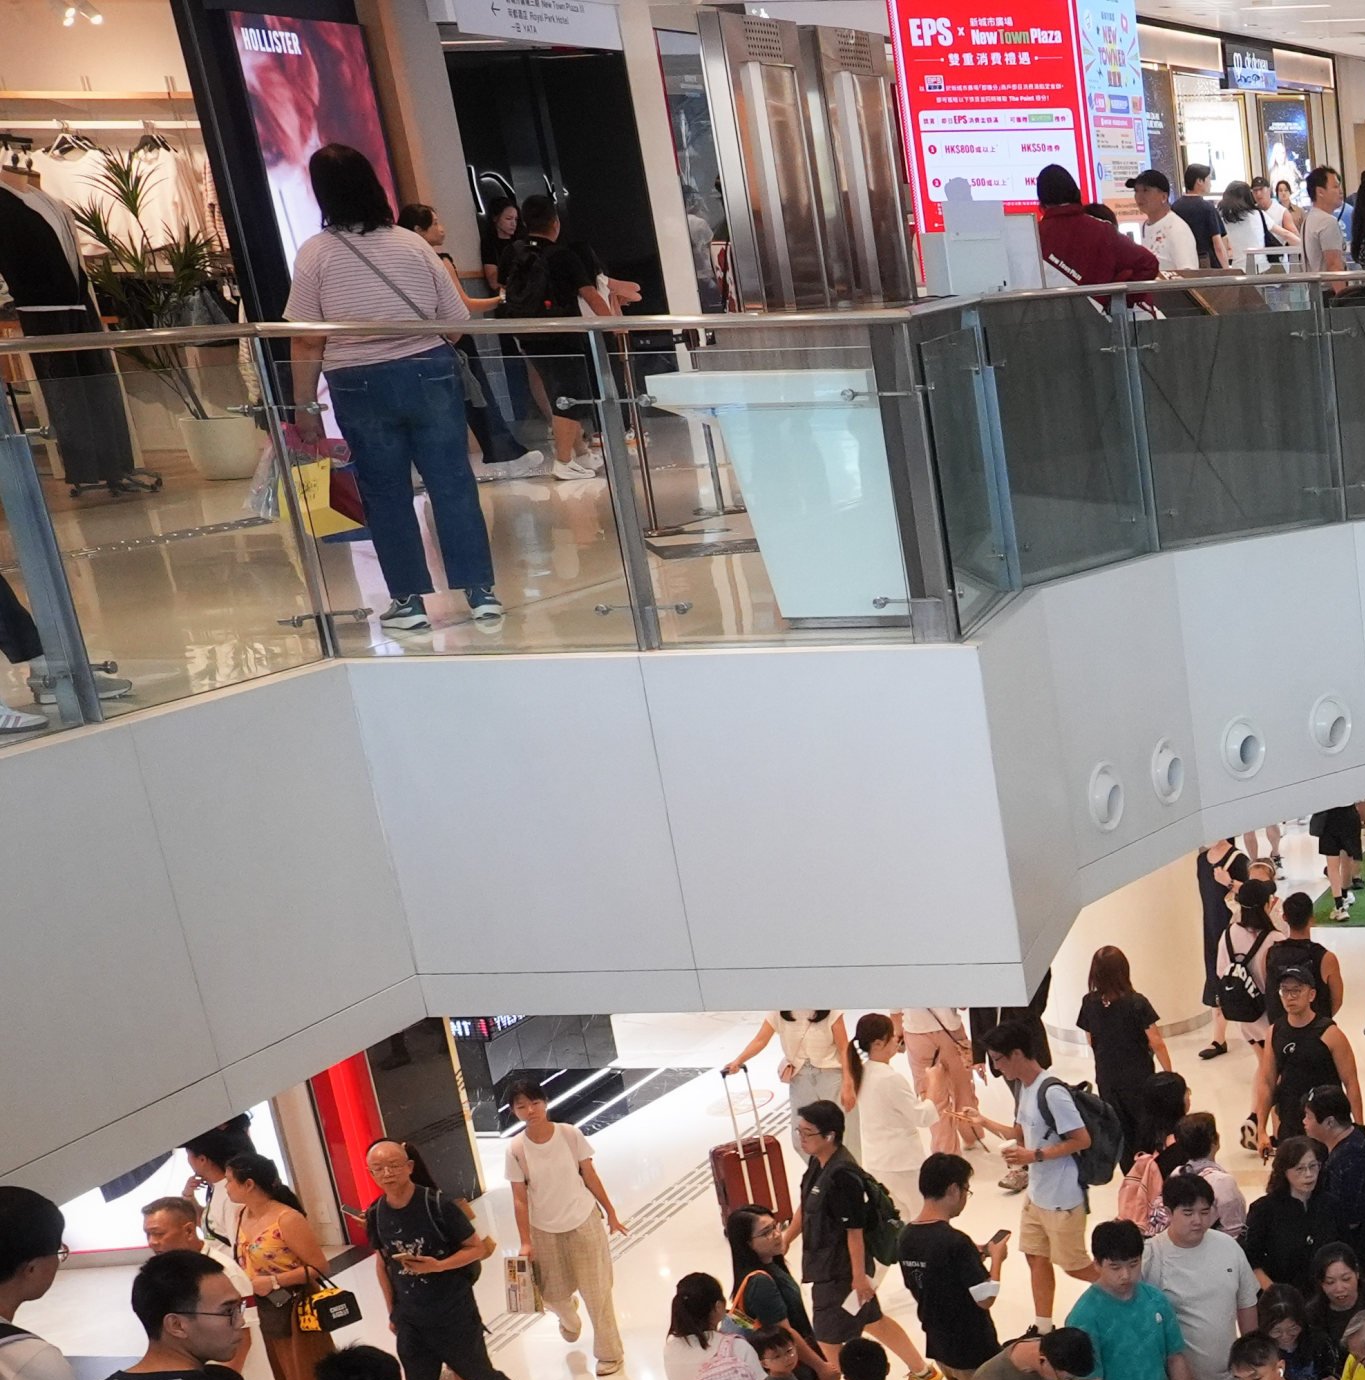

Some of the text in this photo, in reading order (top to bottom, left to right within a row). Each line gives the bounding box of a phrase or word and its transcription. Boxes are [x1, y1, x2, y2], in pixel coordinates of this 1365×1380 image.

[241, 27, 302, 55] HOLLISTER
[908, 18, 954, 47] EPS
[971, 29, 998, 45] New
[998, 29, 1030, 45] Town
[1030, 28, 1062, 44] Plaza
